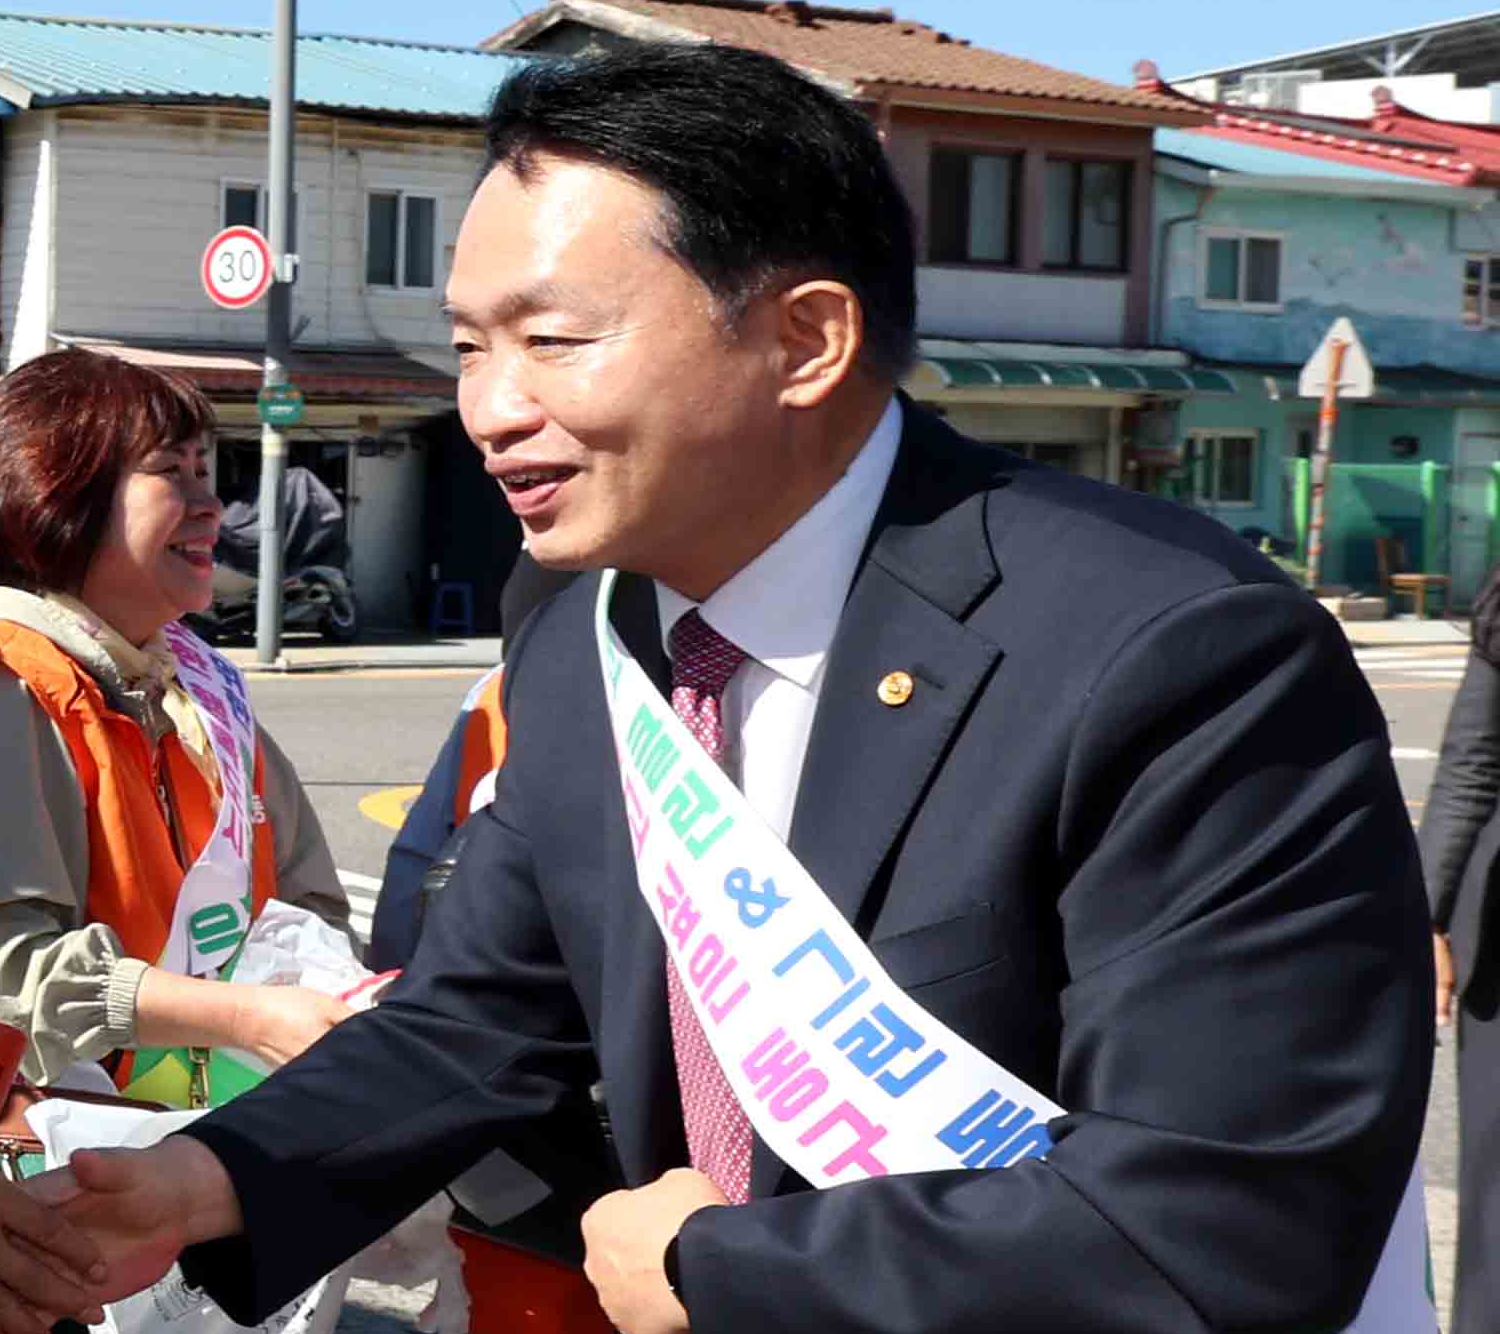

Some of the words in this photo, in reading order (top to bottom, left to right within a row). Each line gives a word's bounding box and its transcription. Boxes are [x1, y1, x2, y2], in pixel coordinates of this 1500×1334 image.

[218, 250, 257, 284] 30
[723, 866, 794, 929] &
[771, 927, 949, 1101] 그린
[741, 1025, 890, 1177] 동구
